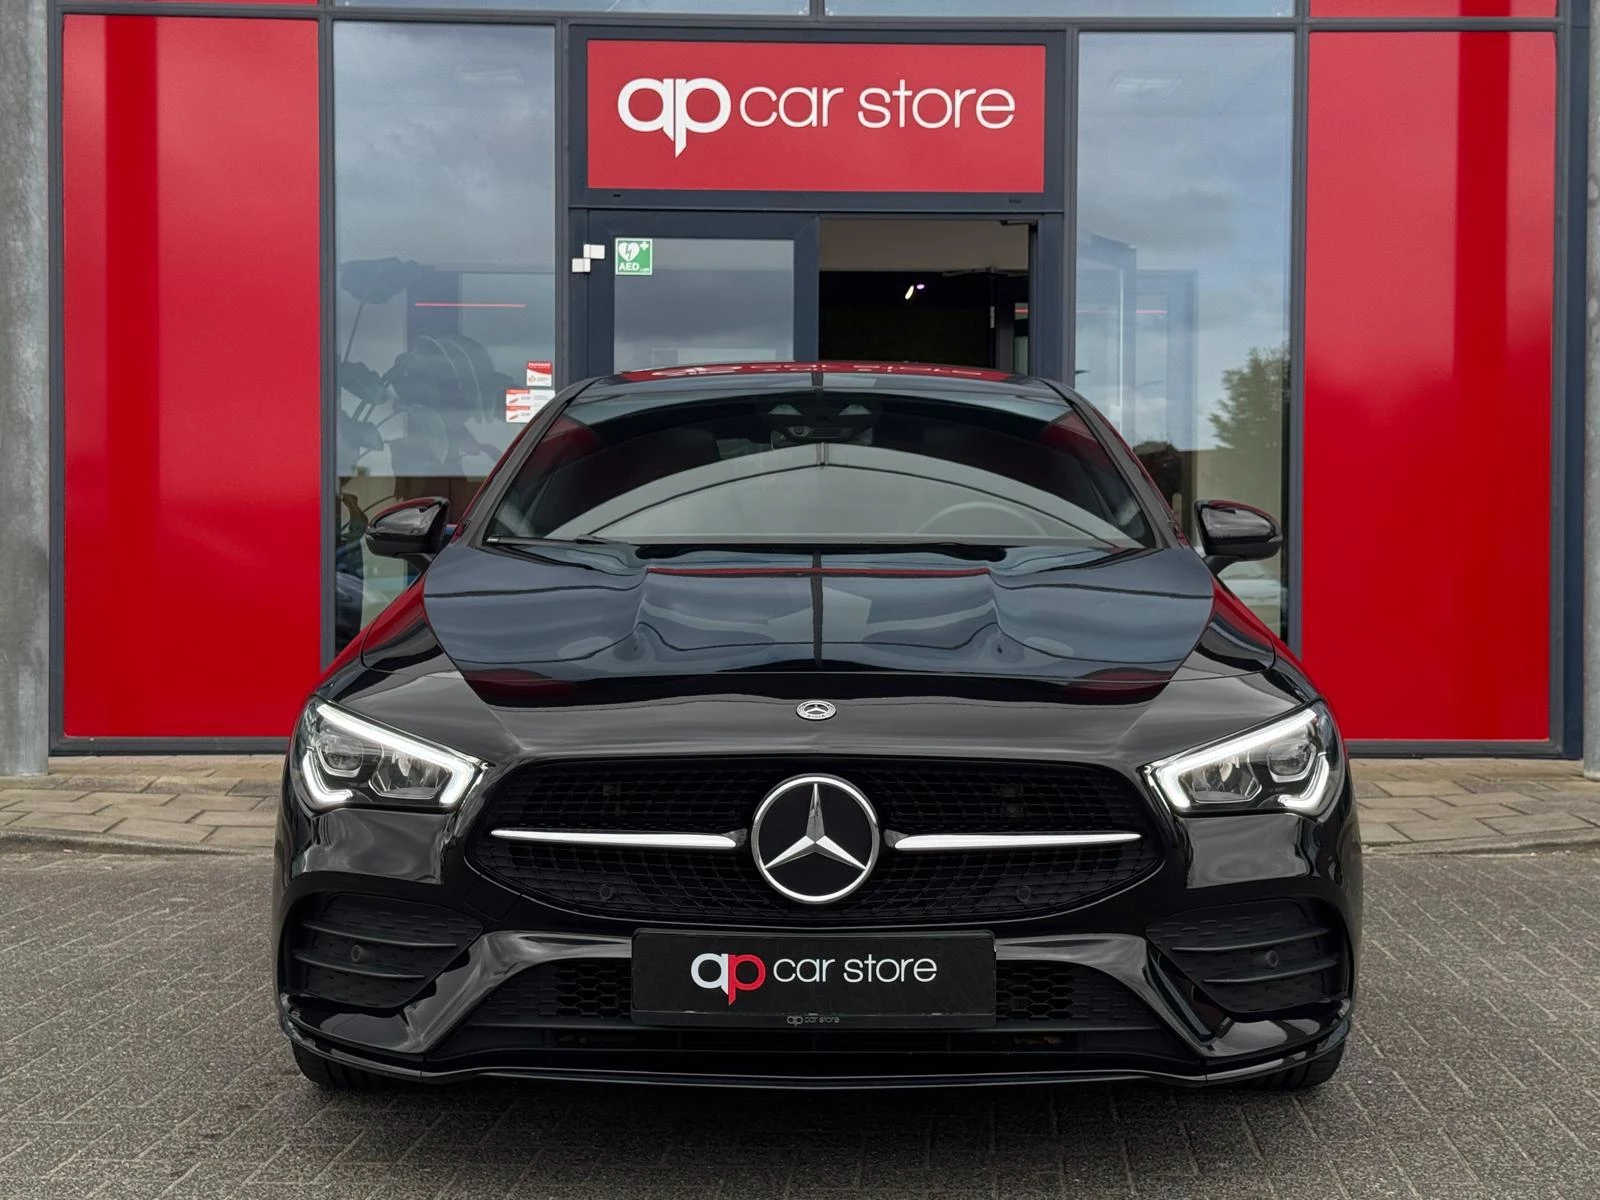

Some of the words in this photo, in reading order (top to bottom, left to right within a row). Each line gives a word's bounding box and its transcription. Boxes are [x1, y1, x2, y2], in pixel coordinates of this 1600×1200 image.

[739, 86, 845, 128] car
[857, 79, 1016, 130] store
[618, 262, 640, 271] AED
[773, 957, 836, 983] car
[843, 953, 938, 983] store
[818, 1016, 840, 1024] store
